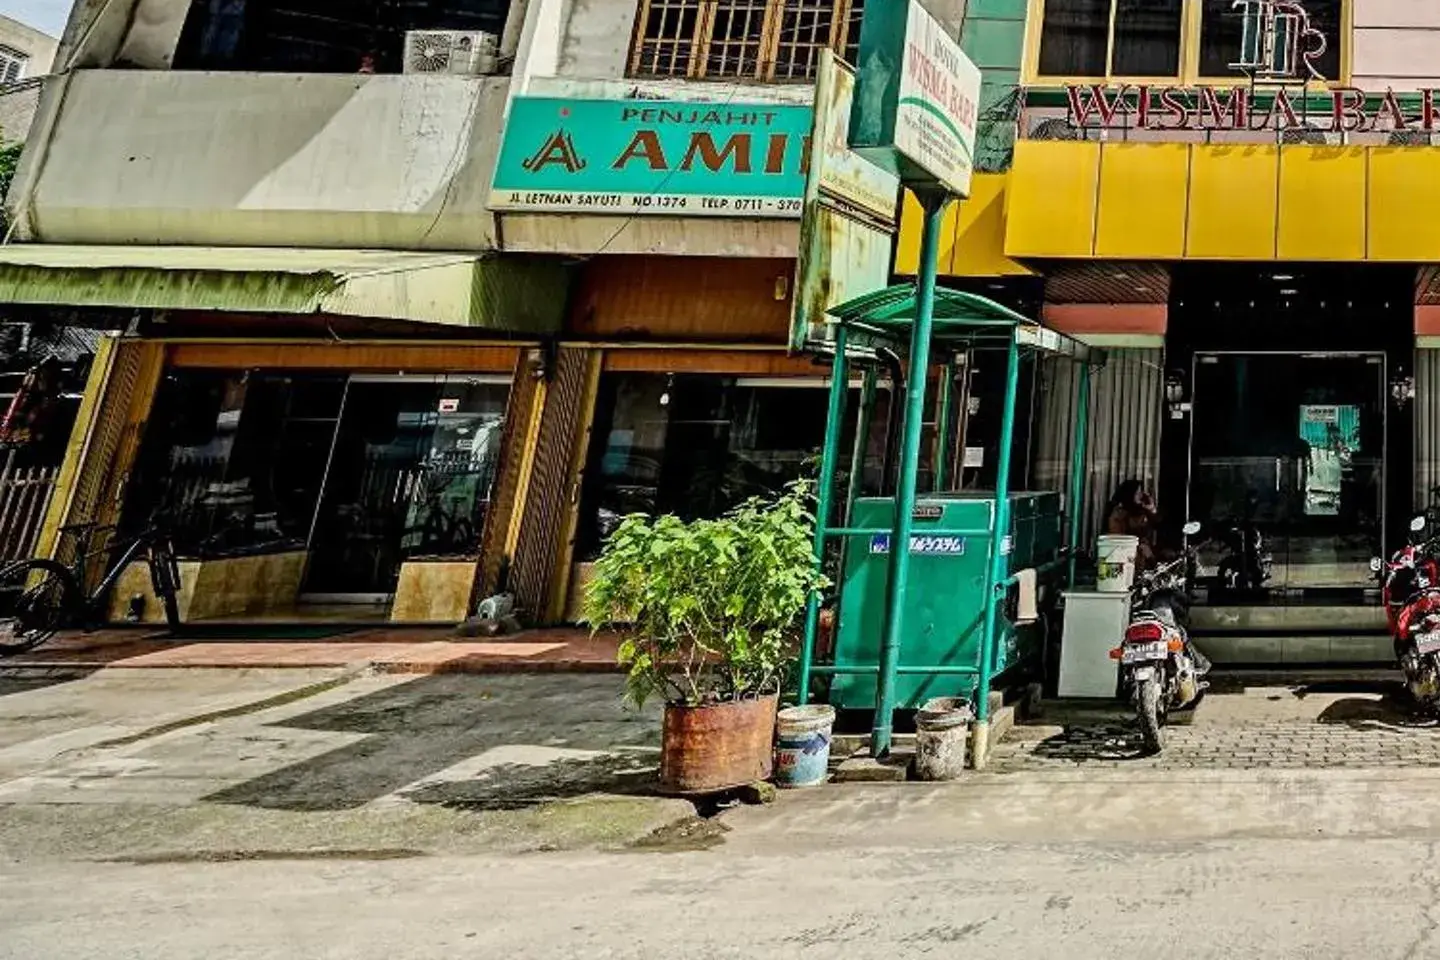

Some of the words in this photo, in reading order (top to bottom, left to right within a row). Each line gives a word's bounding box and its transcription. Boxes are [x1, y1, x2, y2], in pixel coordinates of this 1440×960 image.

[621, 107, 778, 126] PENJAHIT
[1065, 83, 1299, 131] WISMA
[609, 129, 812, 176] AMI
